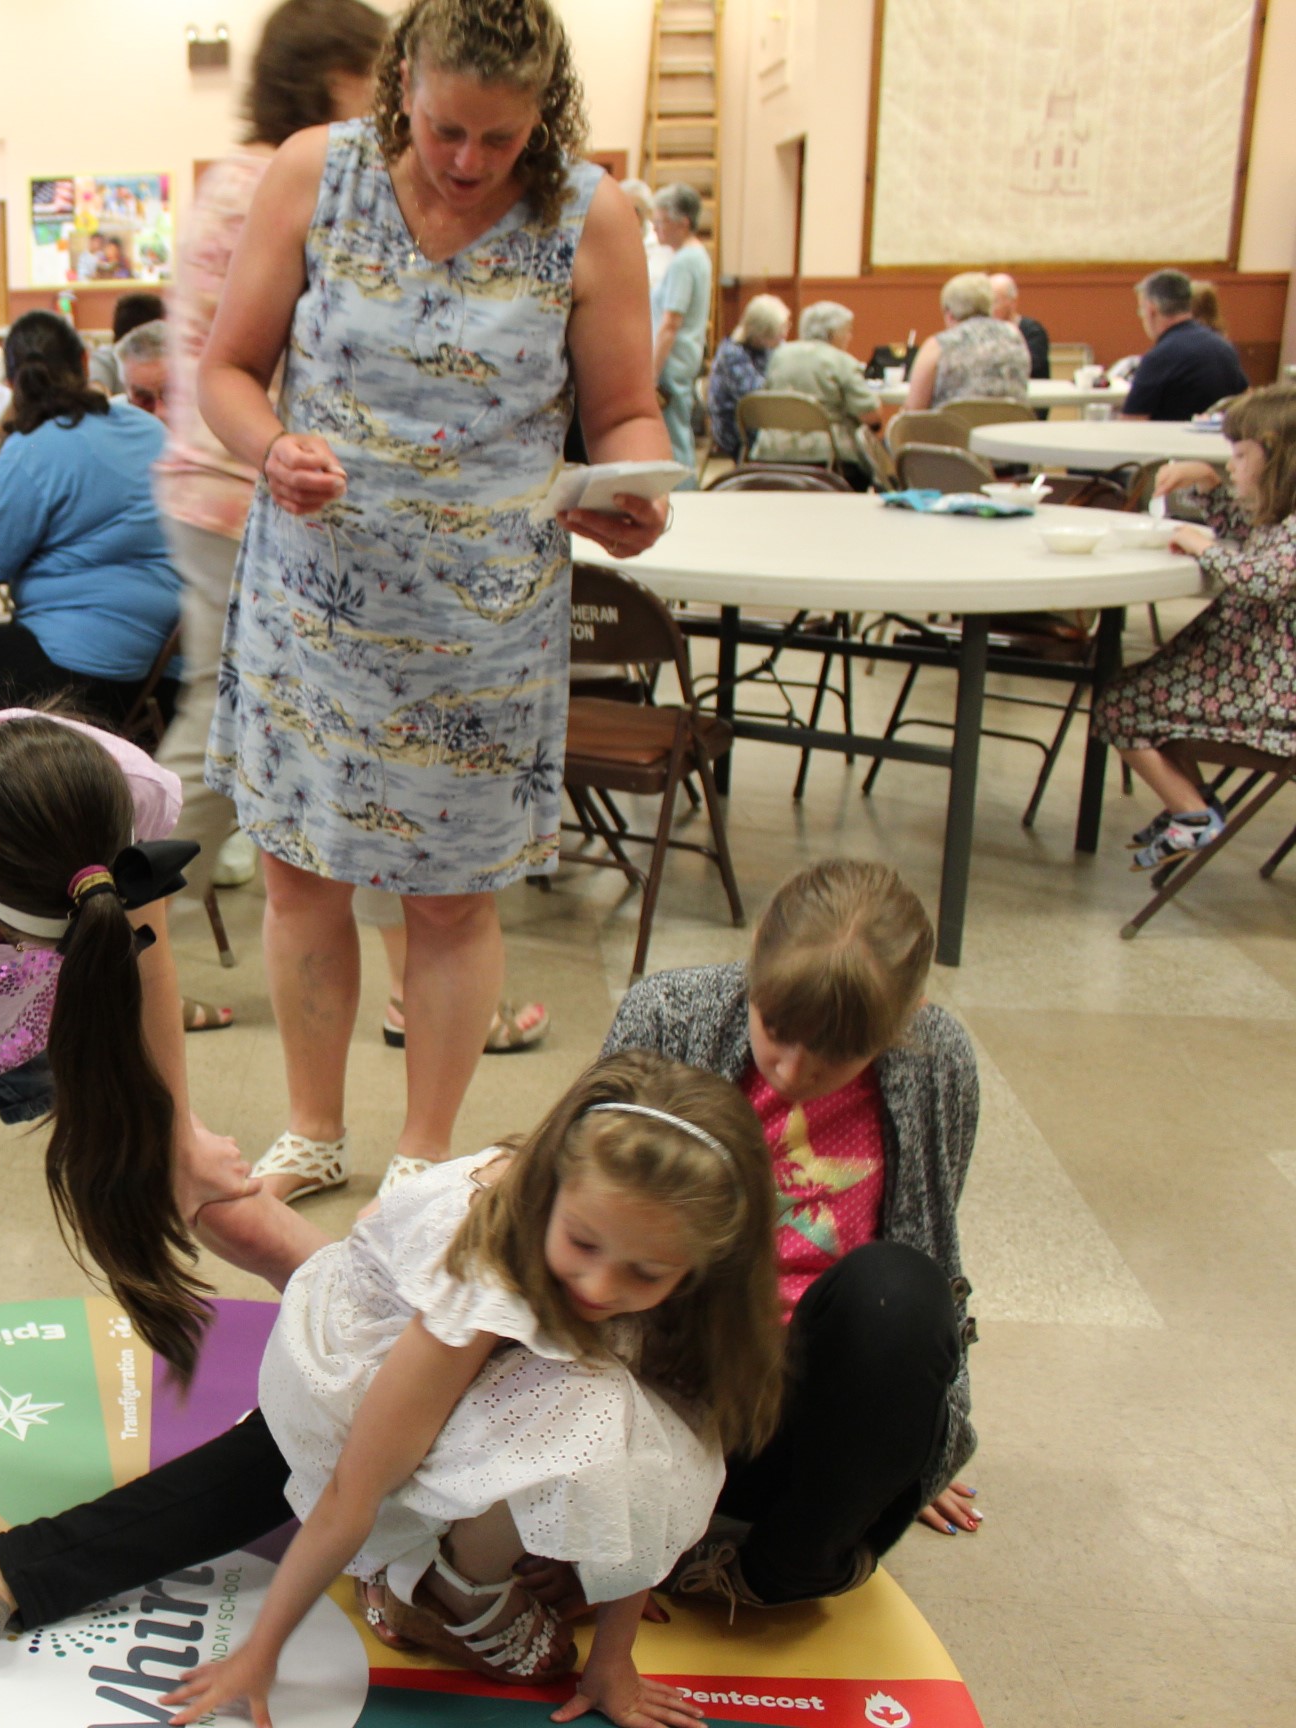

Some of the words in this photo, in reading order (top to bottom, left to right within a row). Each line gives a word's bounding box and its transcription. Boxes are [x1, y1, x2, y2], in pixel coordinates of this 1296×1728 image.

[572, 604, 619, 624] HERAN
[116, 1349, 142, 1441] Transfiguration
[218, 1566, 243, 1621] SCHOOL
[209, 1624, 233, 1663] NDAY
